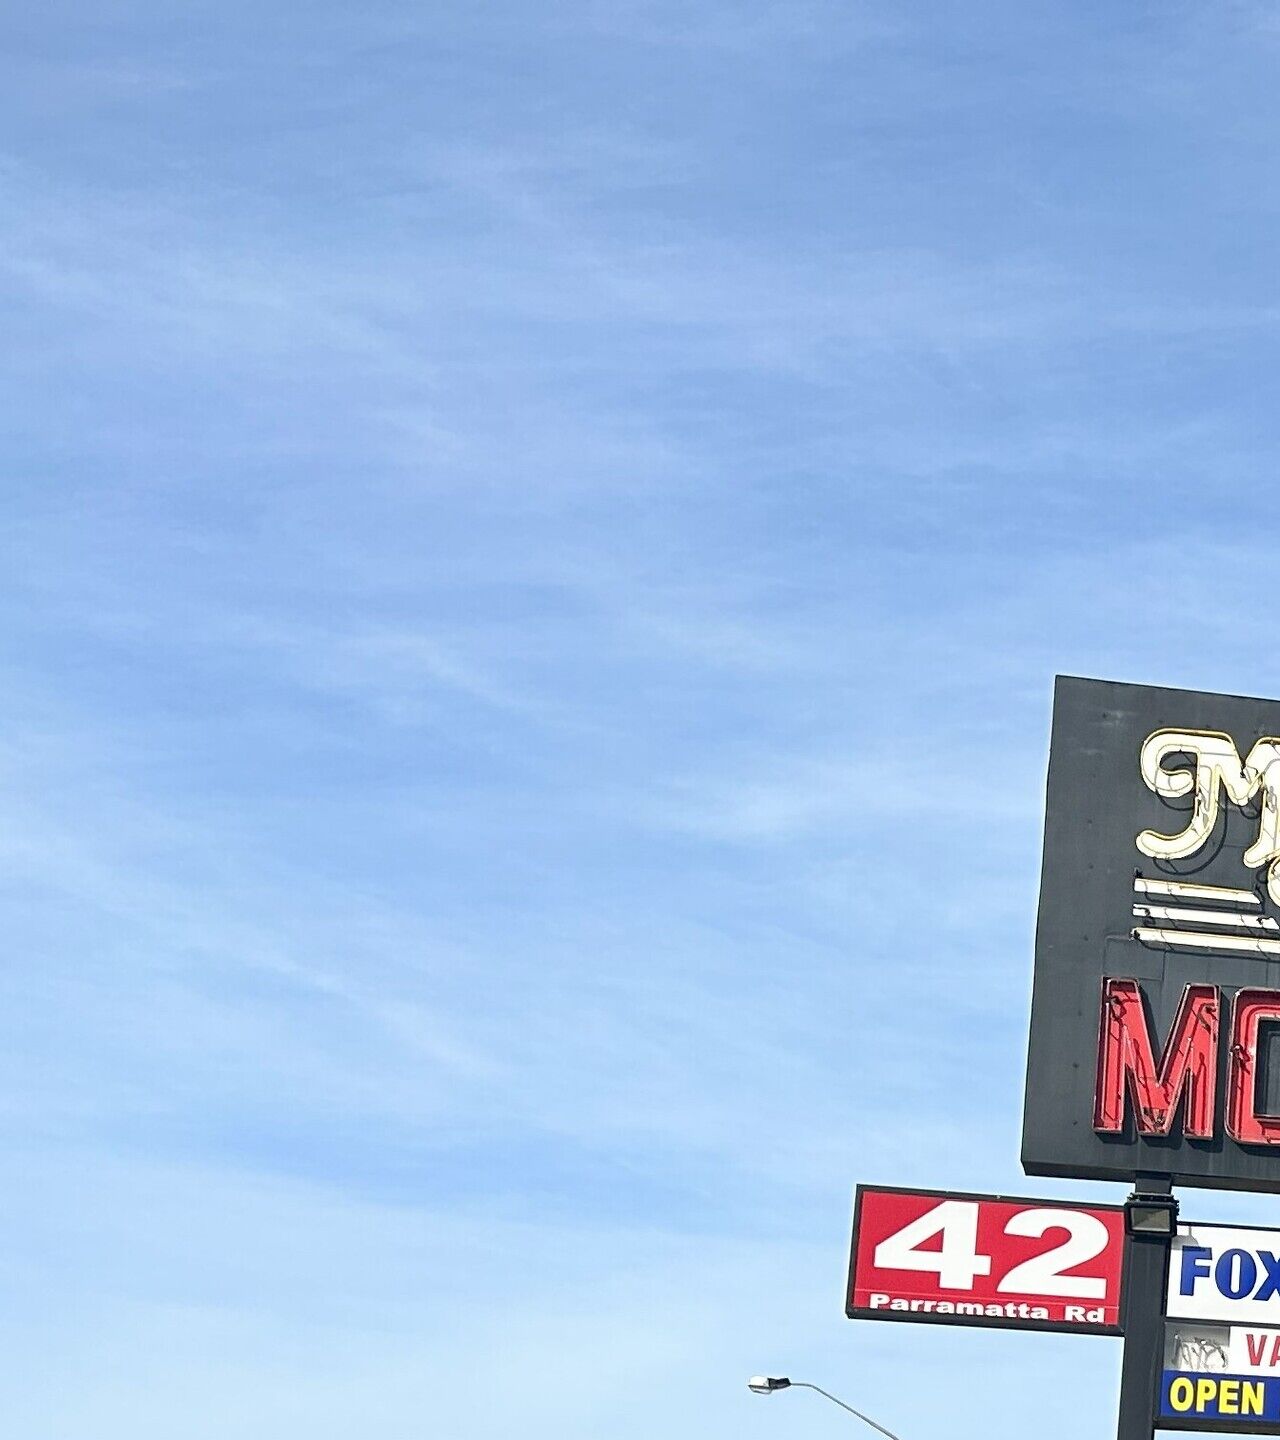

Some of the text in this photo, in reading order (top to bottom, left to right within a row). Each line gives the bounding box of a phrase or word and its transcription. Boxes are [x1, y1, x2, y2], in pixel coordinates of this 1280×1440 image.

[873, 1200, 1109, 1299] 42
[869, 1293, 1105, 1324] Parramatta Rd
[1169, 1376, 1264, 1416] OPEN
